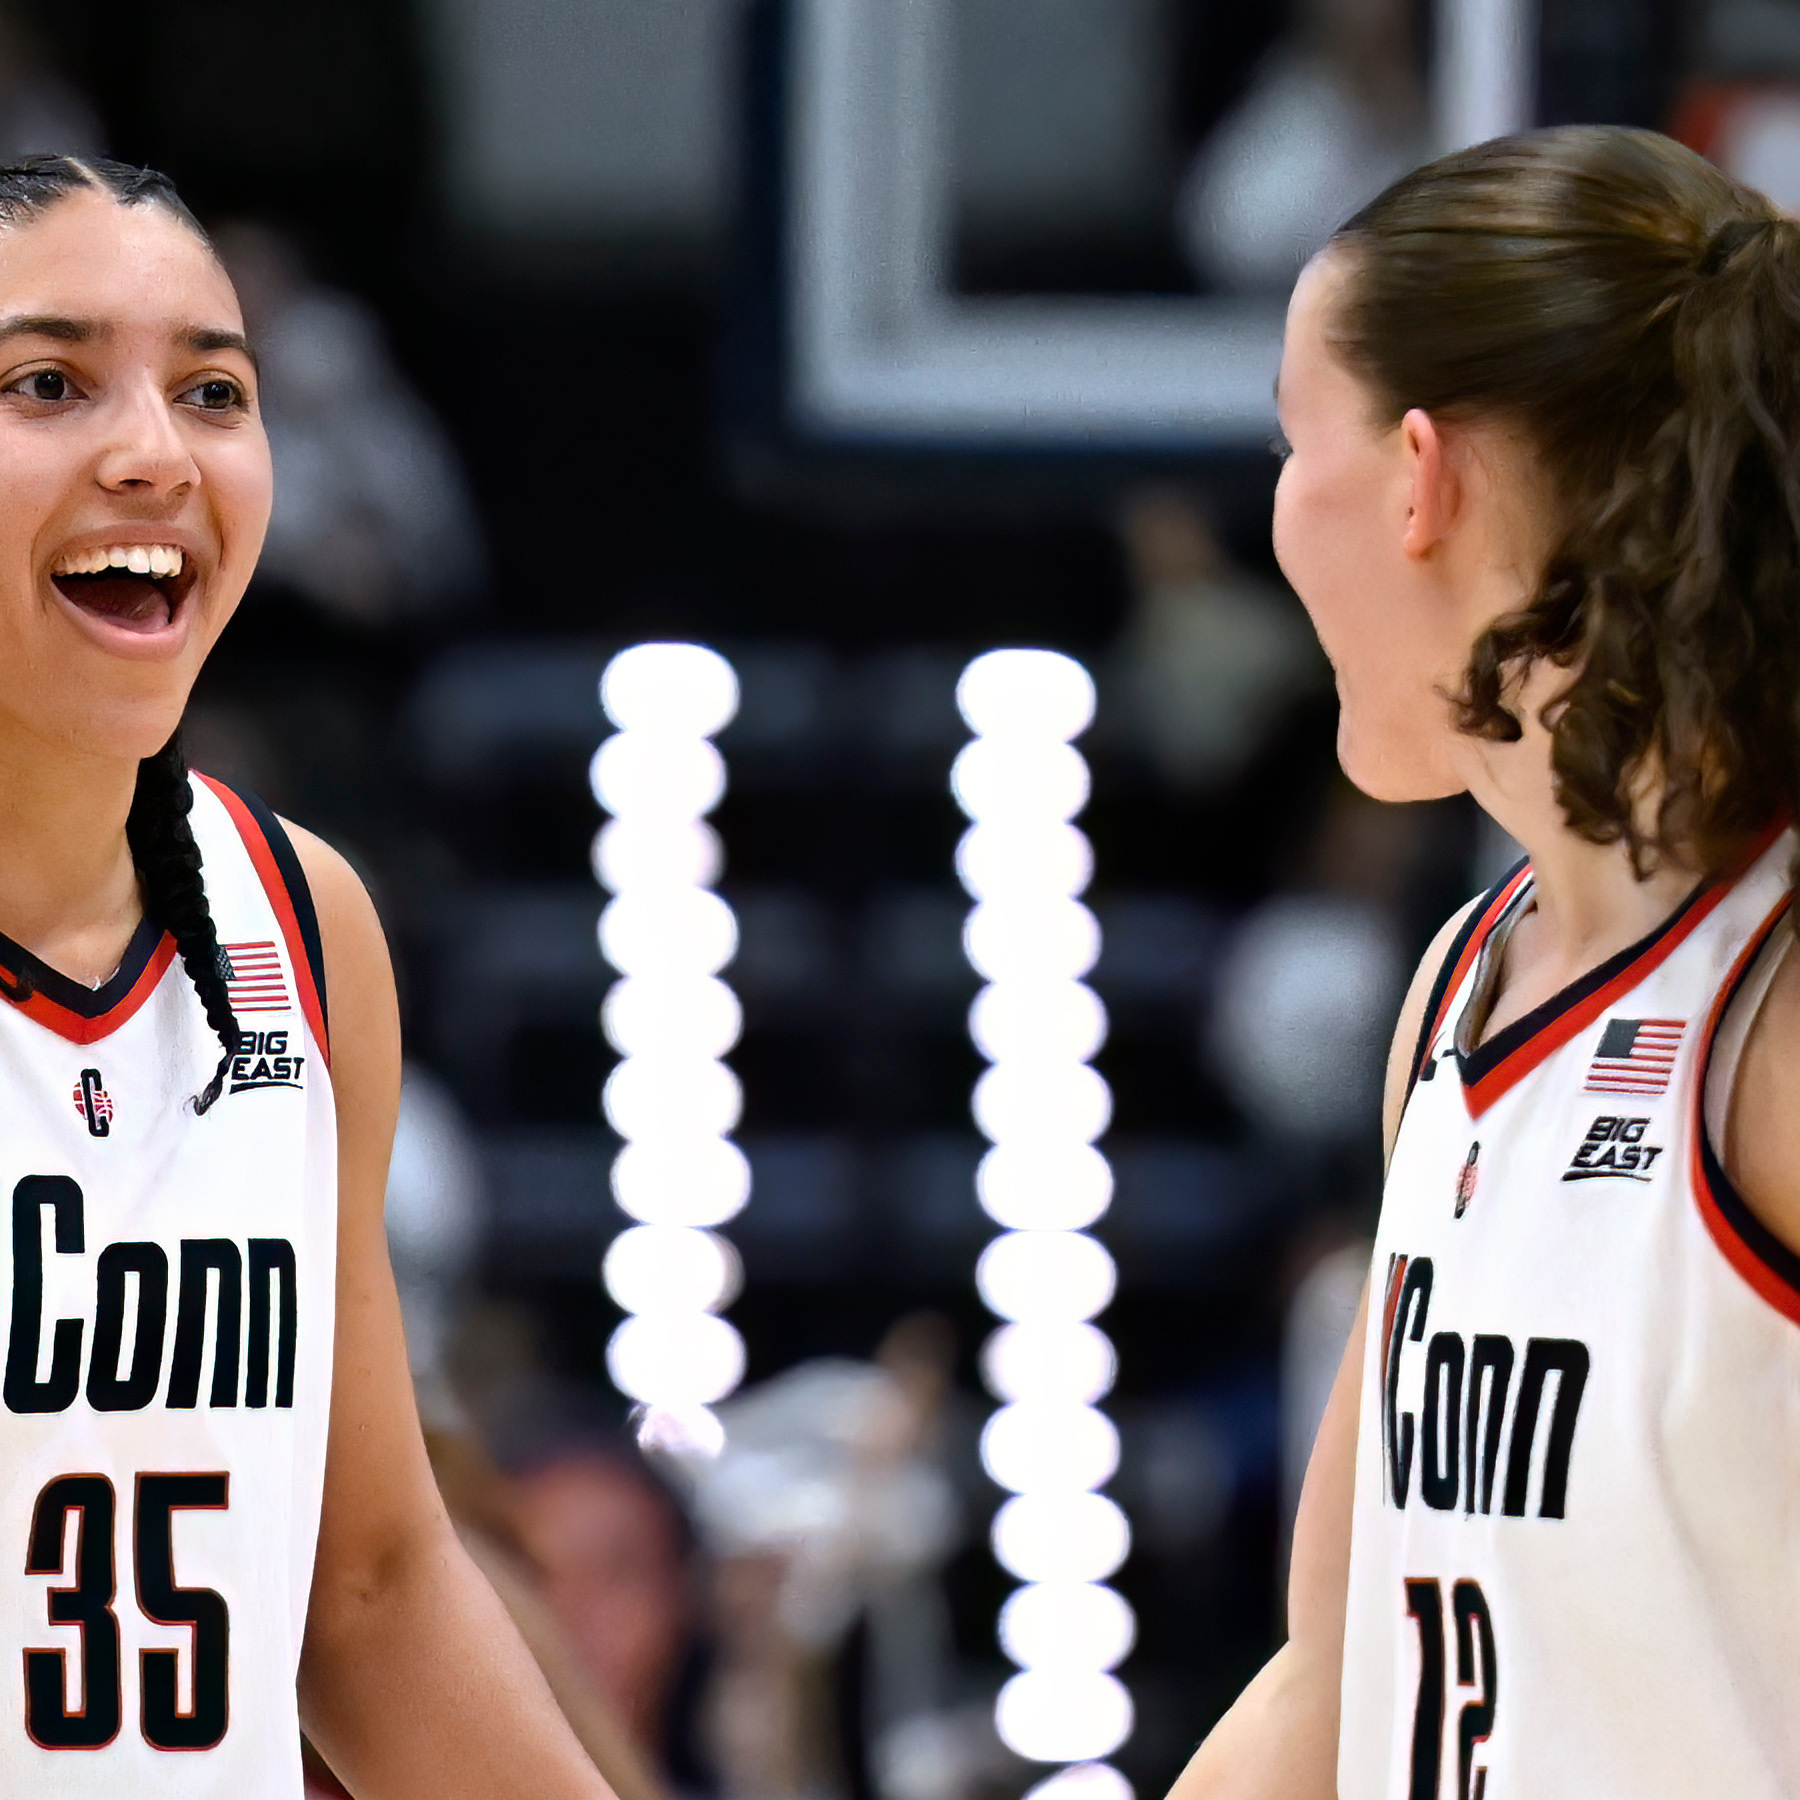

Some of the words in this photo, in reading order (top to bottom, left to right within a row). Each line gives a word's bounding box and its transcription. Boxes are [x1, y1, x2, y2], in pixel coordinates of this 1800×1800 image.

[236, 1030, 289, 1055] BIG
[231, 1057, 305, 1080] EAST
[1584, 1115, 1651, 1143] BIG
[1570, 1142, 1663, 1170] EAST
[22, 1471, 232, 1752] 35
